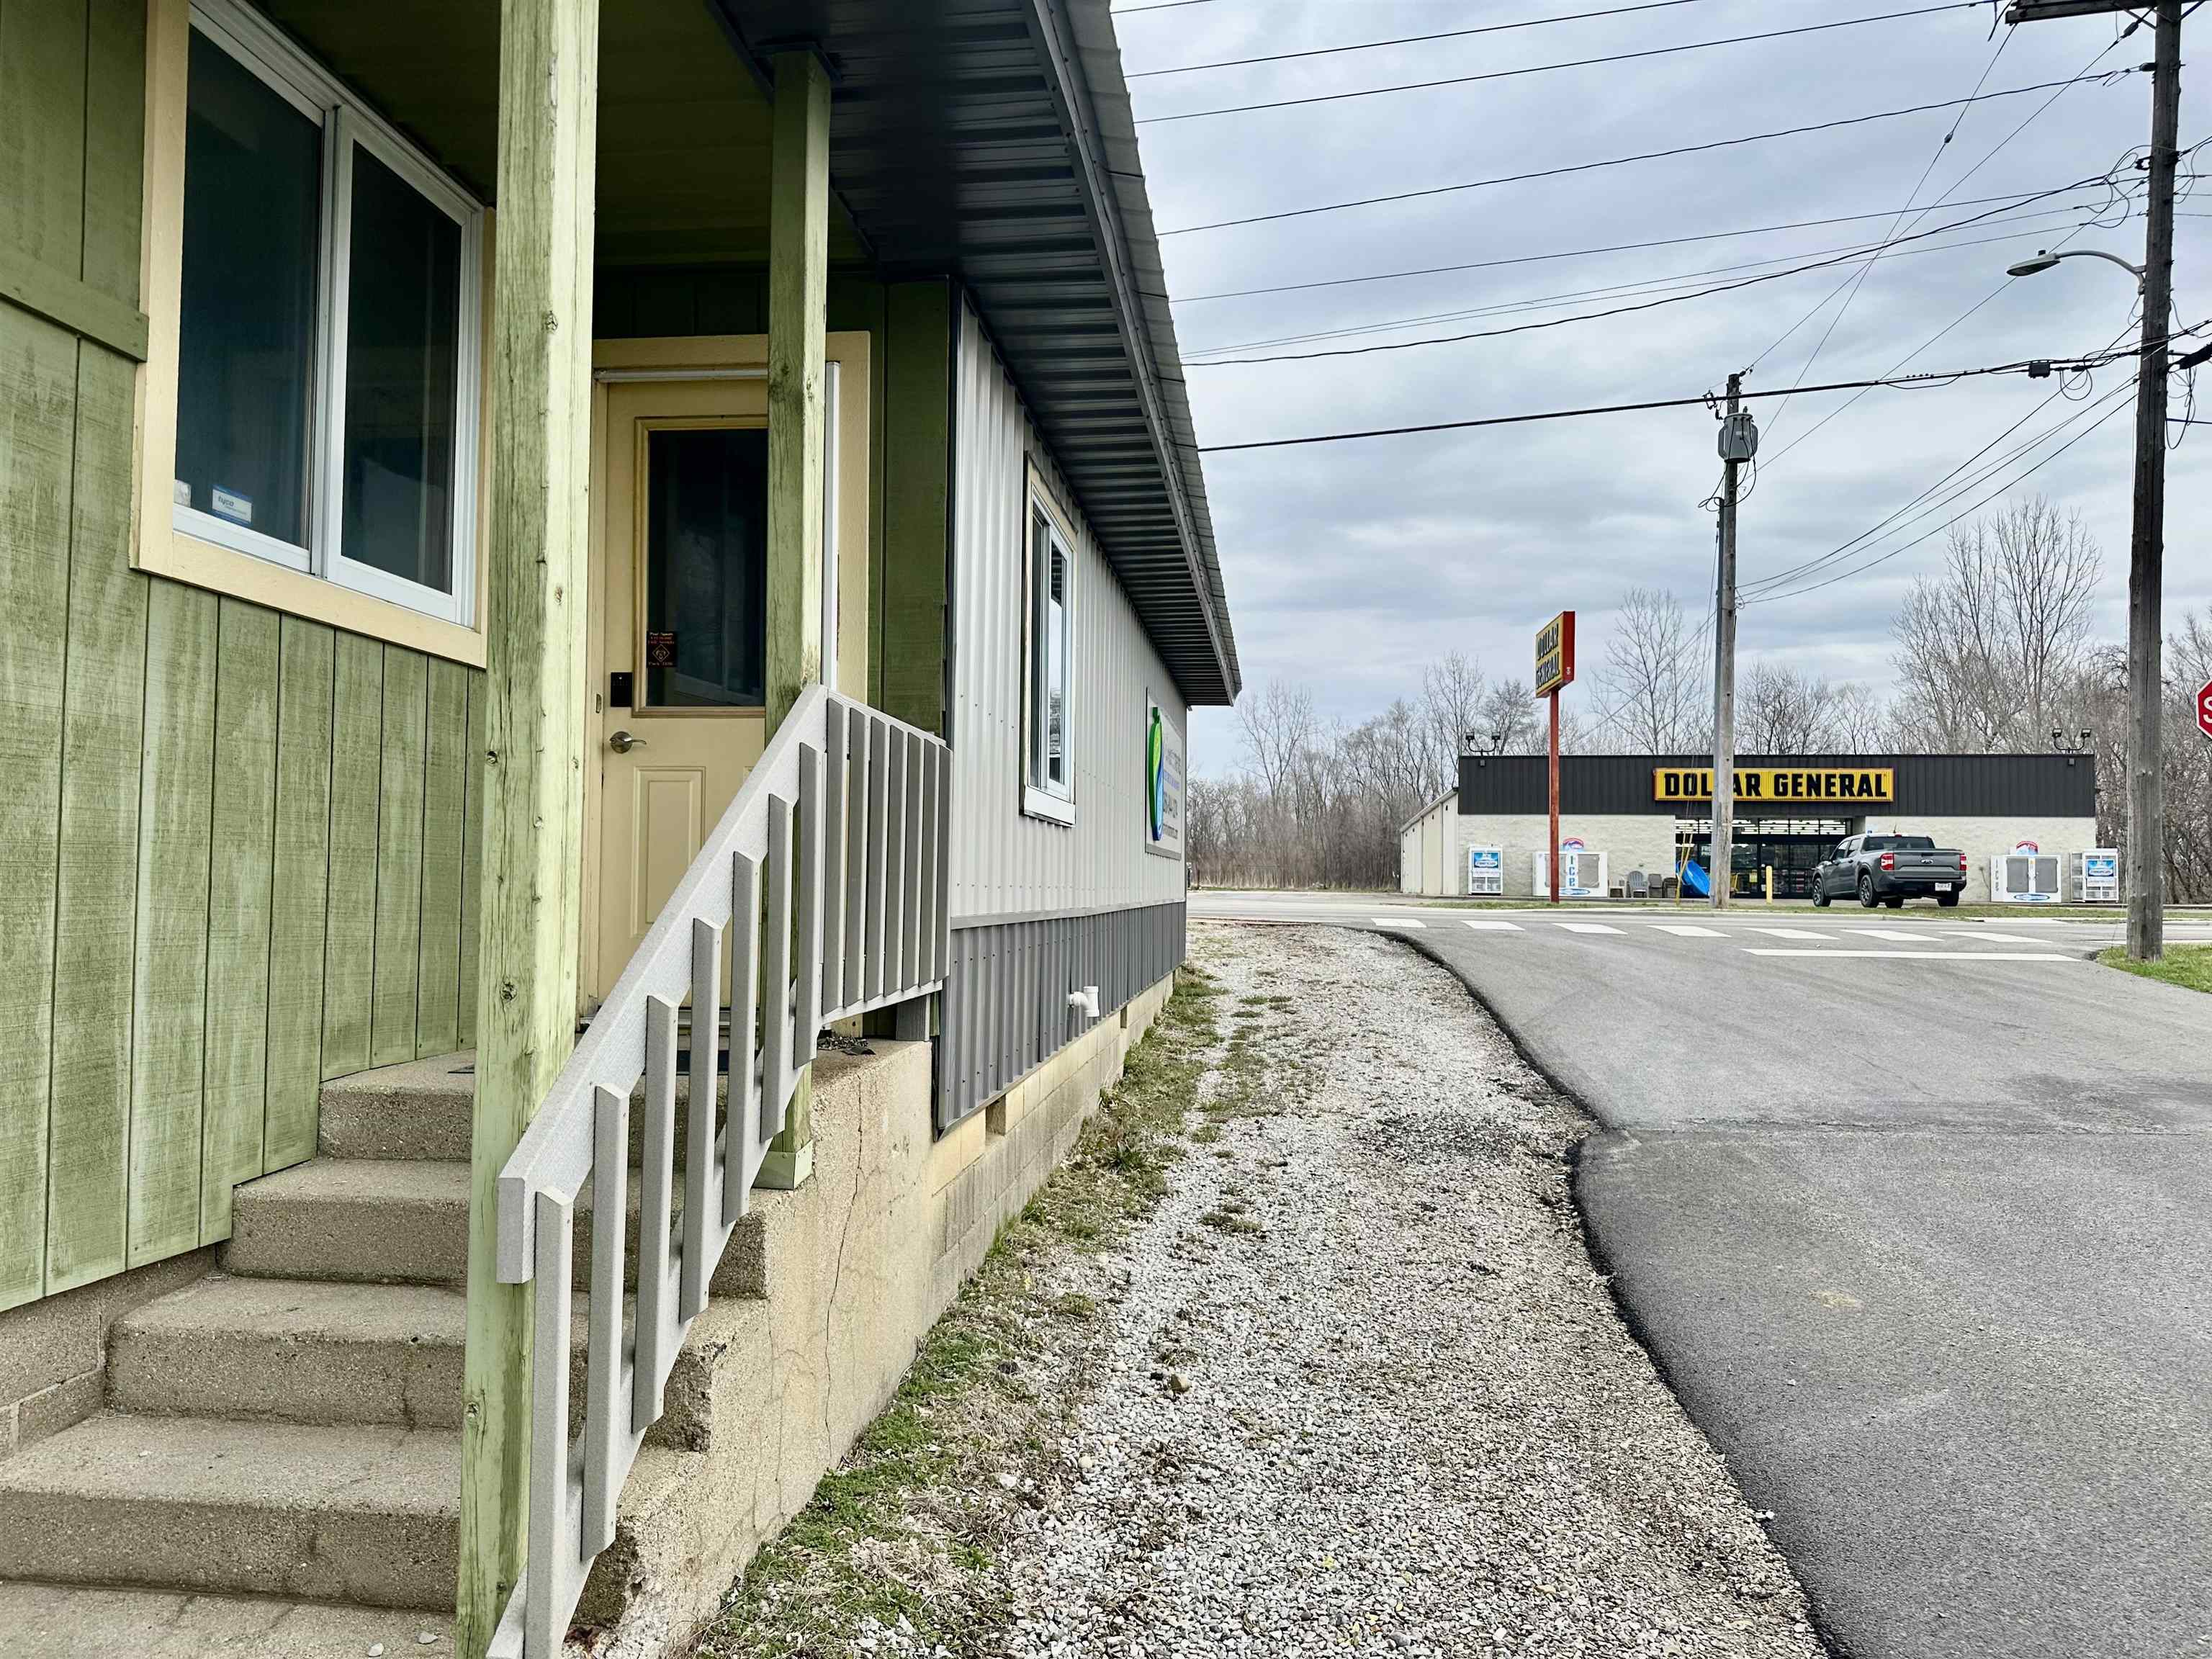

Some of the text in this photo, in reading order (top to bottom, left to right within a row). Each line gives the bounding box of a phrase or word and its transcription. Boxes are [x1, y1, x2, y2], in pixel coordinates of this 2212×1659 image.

[1537, 623, 1559, 661] DOLLAR
[1536, 652, 1560, 690] GENERAL
[1664, 773, 1887, 797] DOLAR GENERAL
